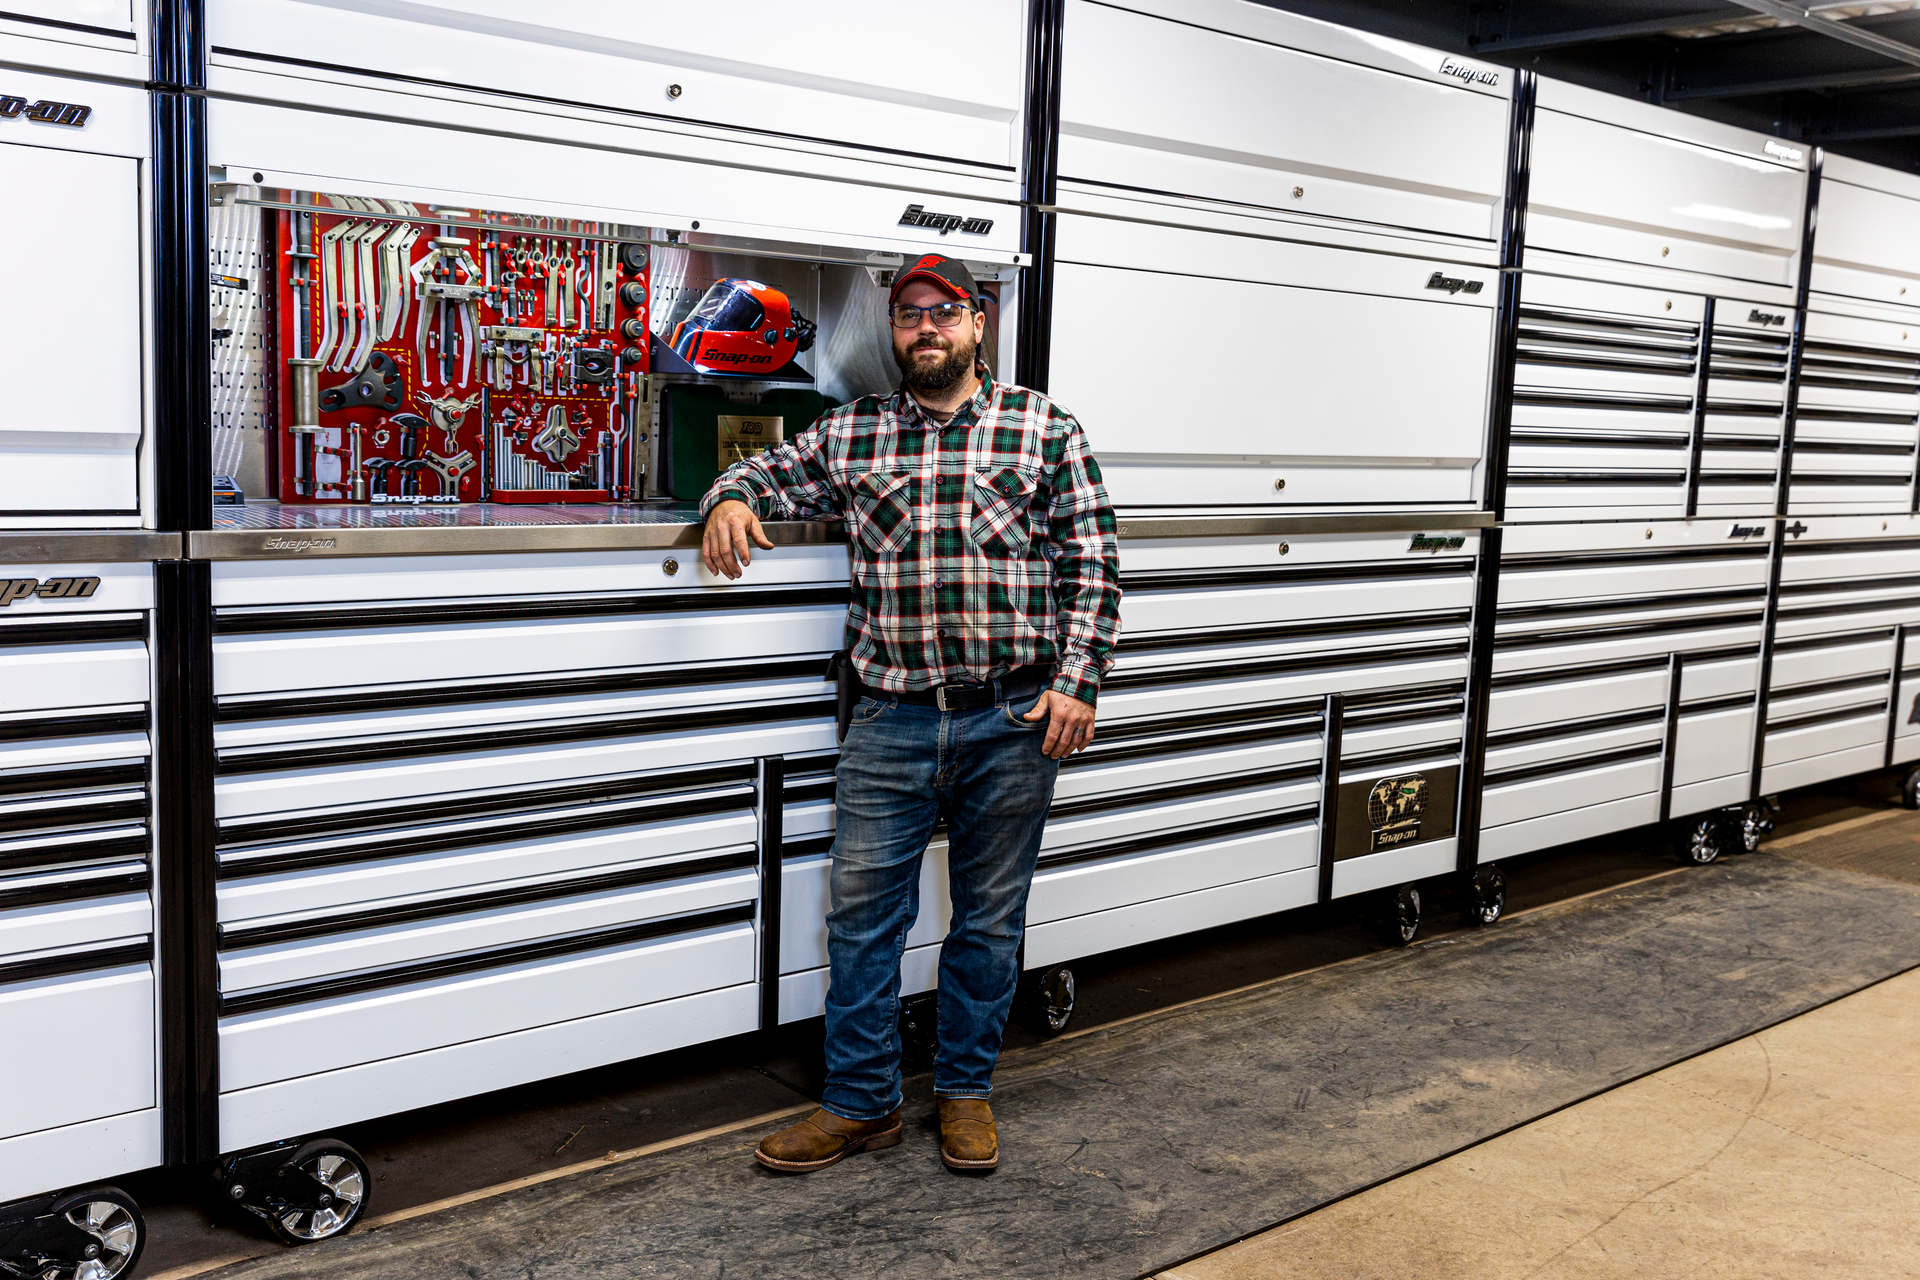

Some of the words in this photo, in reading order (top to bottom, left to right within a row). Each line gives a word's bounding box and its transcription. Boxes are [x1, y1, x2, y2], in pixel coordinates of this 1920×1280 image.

[897, 204, 994, 235] Snap-on
[1425, 272, 1484, 295] Snap-on
[701, 349, 772, 365] Snap-on
[370, 493, 460, 505] Snap-on
[264, 537, 335, 552] Snap-on
[1407, 533, 1465, 554] Snap-on
[1377, 829, 1417, 846] Snap-on
